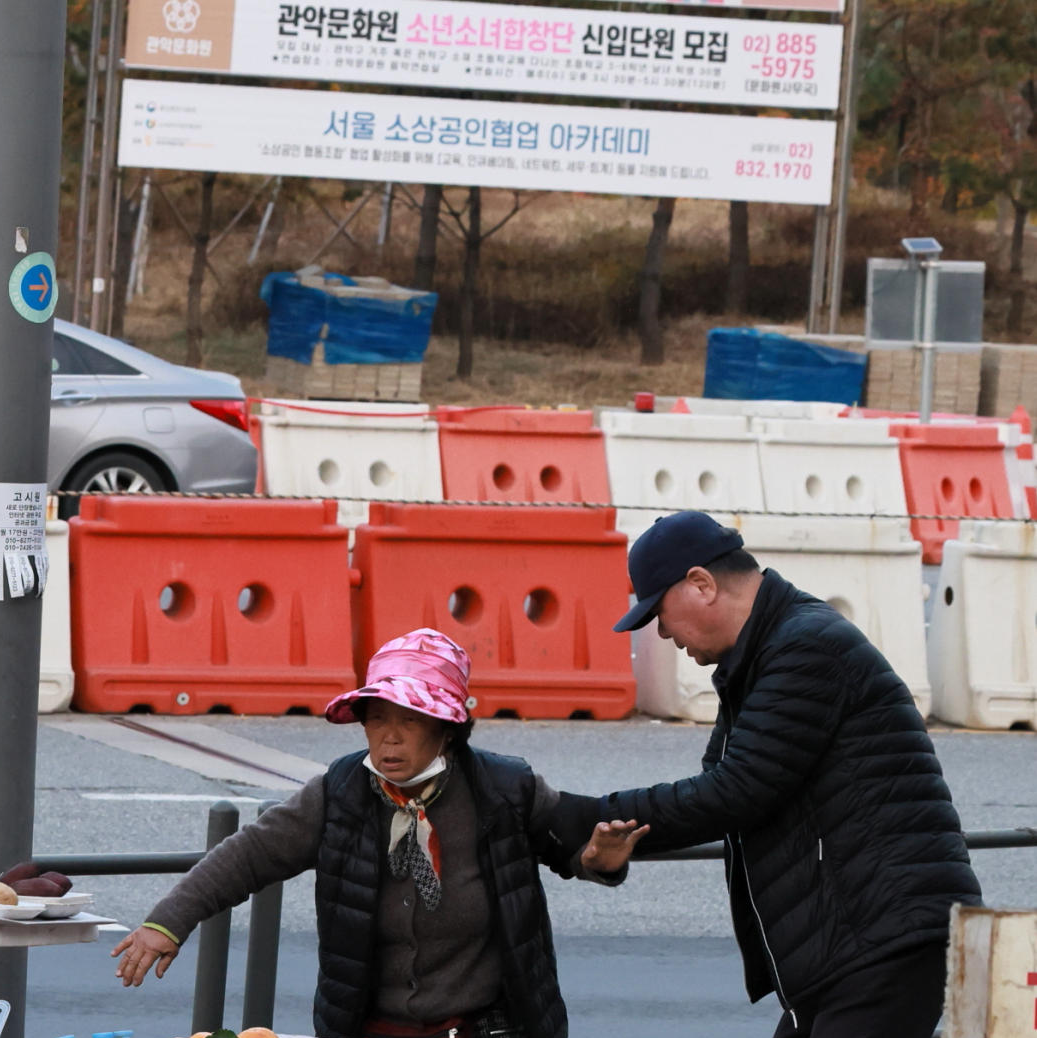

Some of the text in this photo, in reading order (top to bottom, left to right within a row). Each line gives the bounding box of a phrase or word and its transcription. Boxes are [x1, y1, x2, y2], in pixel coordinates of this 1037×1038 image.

[278, 5, 729, 63] 관악문화원 소년소녀합창단 신입단원 모집
[743, 33, 817, 55] 02) 885
[751, 57, 815, 79] -5975
[323, 110, 650, 156] 서울 소상공인협업 아카데미
[788, 143, 814, 159] 02)
[735, 159, 812, 180] 832.1970
